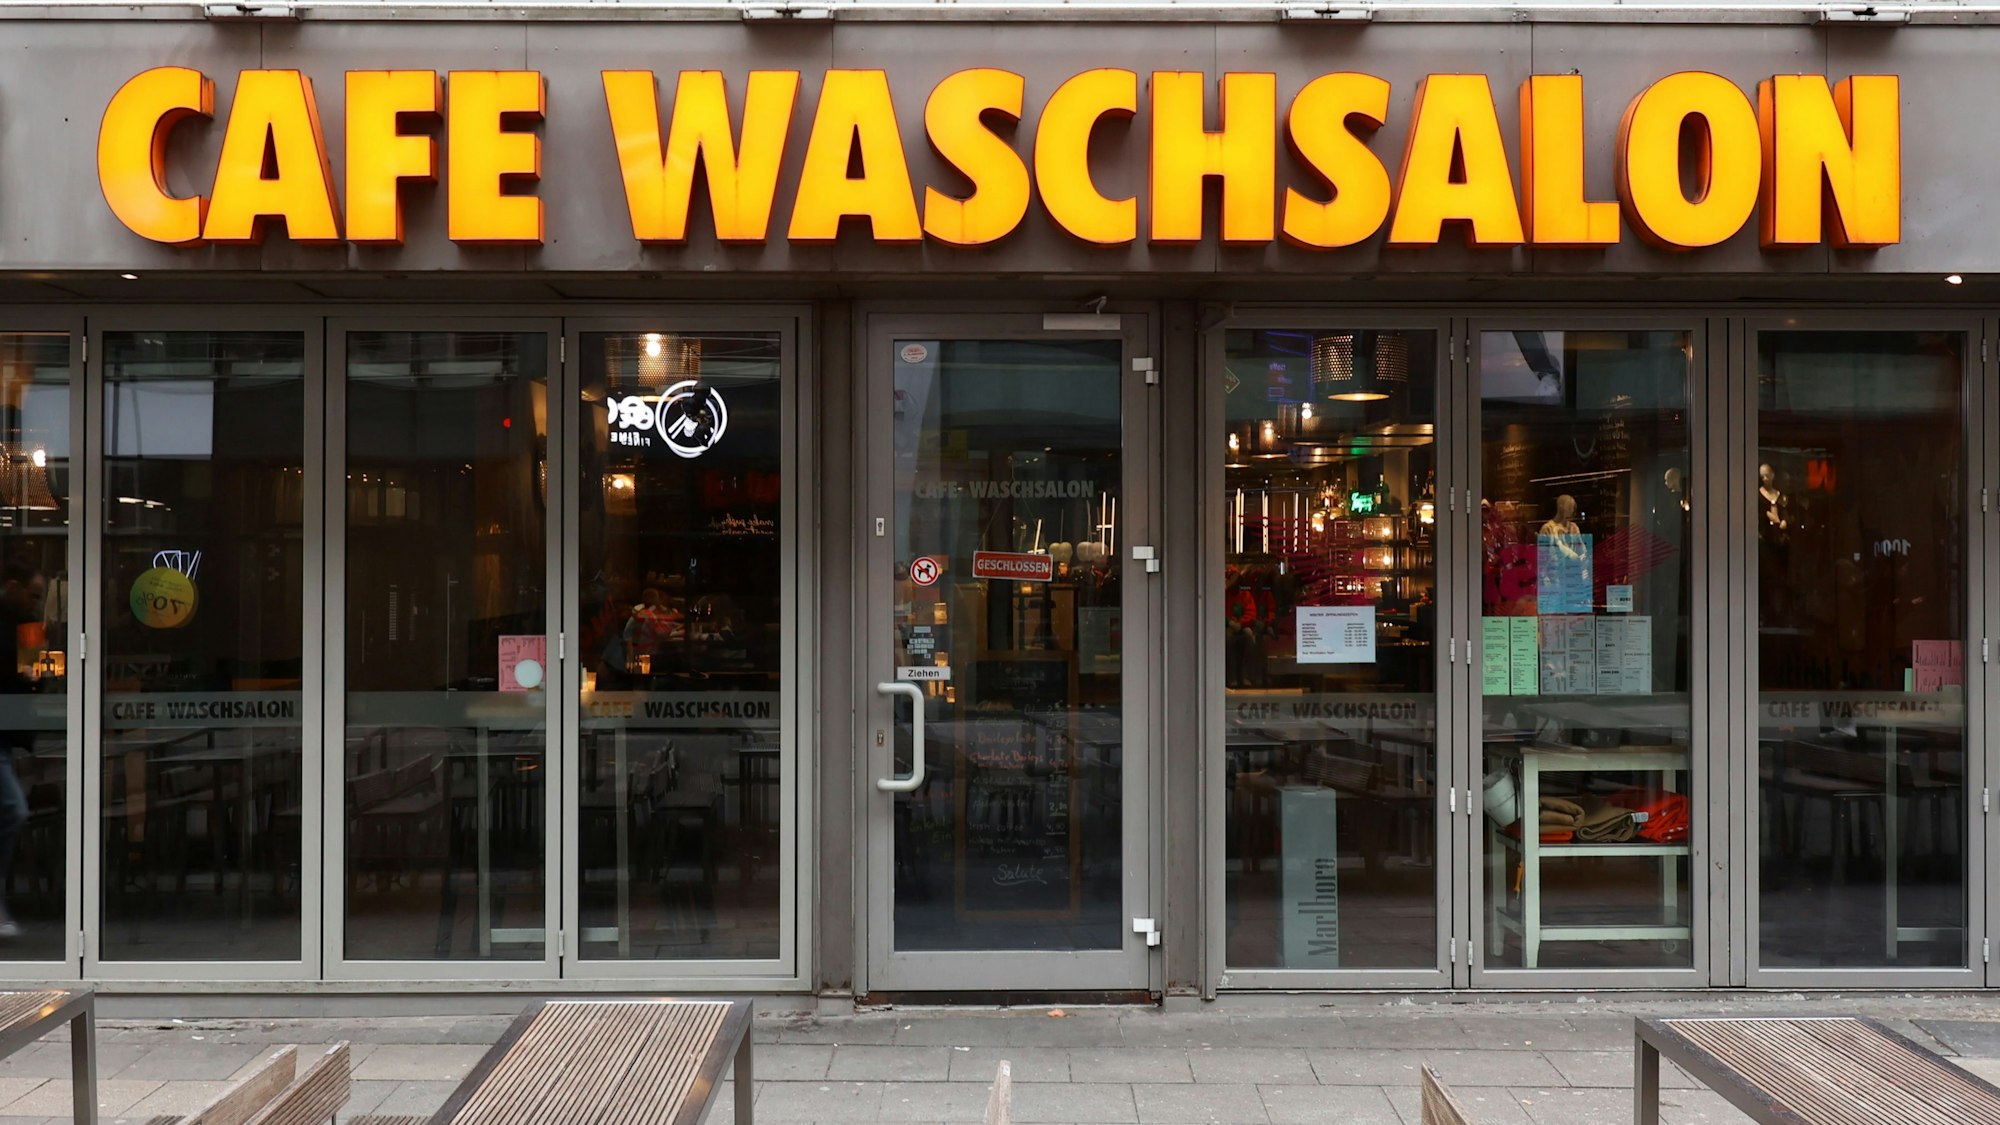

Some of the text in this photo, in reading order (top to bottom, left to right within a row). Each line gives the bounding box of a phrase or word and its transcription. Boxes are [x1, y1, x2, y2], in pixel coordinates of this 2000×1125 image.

[97, 66, 1900, 249] CAFE WASCHSALON
[915, 480, 1094, 499] CAFE WASCHSALON
[977, 559, 1049, 573] GESCHLOSSEN
[908, 669, 939, 678] Ziehen
[113, 701, 294, 720] CAFE WASCHSALON
[590, 700, 771, 719] CAFE WASCHSALON
[1238, 702, 1417, 720] CAFE WASCHSALON
[1768, 701, 1810, 718] CAFE
[1298, 858, 1336, 957] Marlboro
